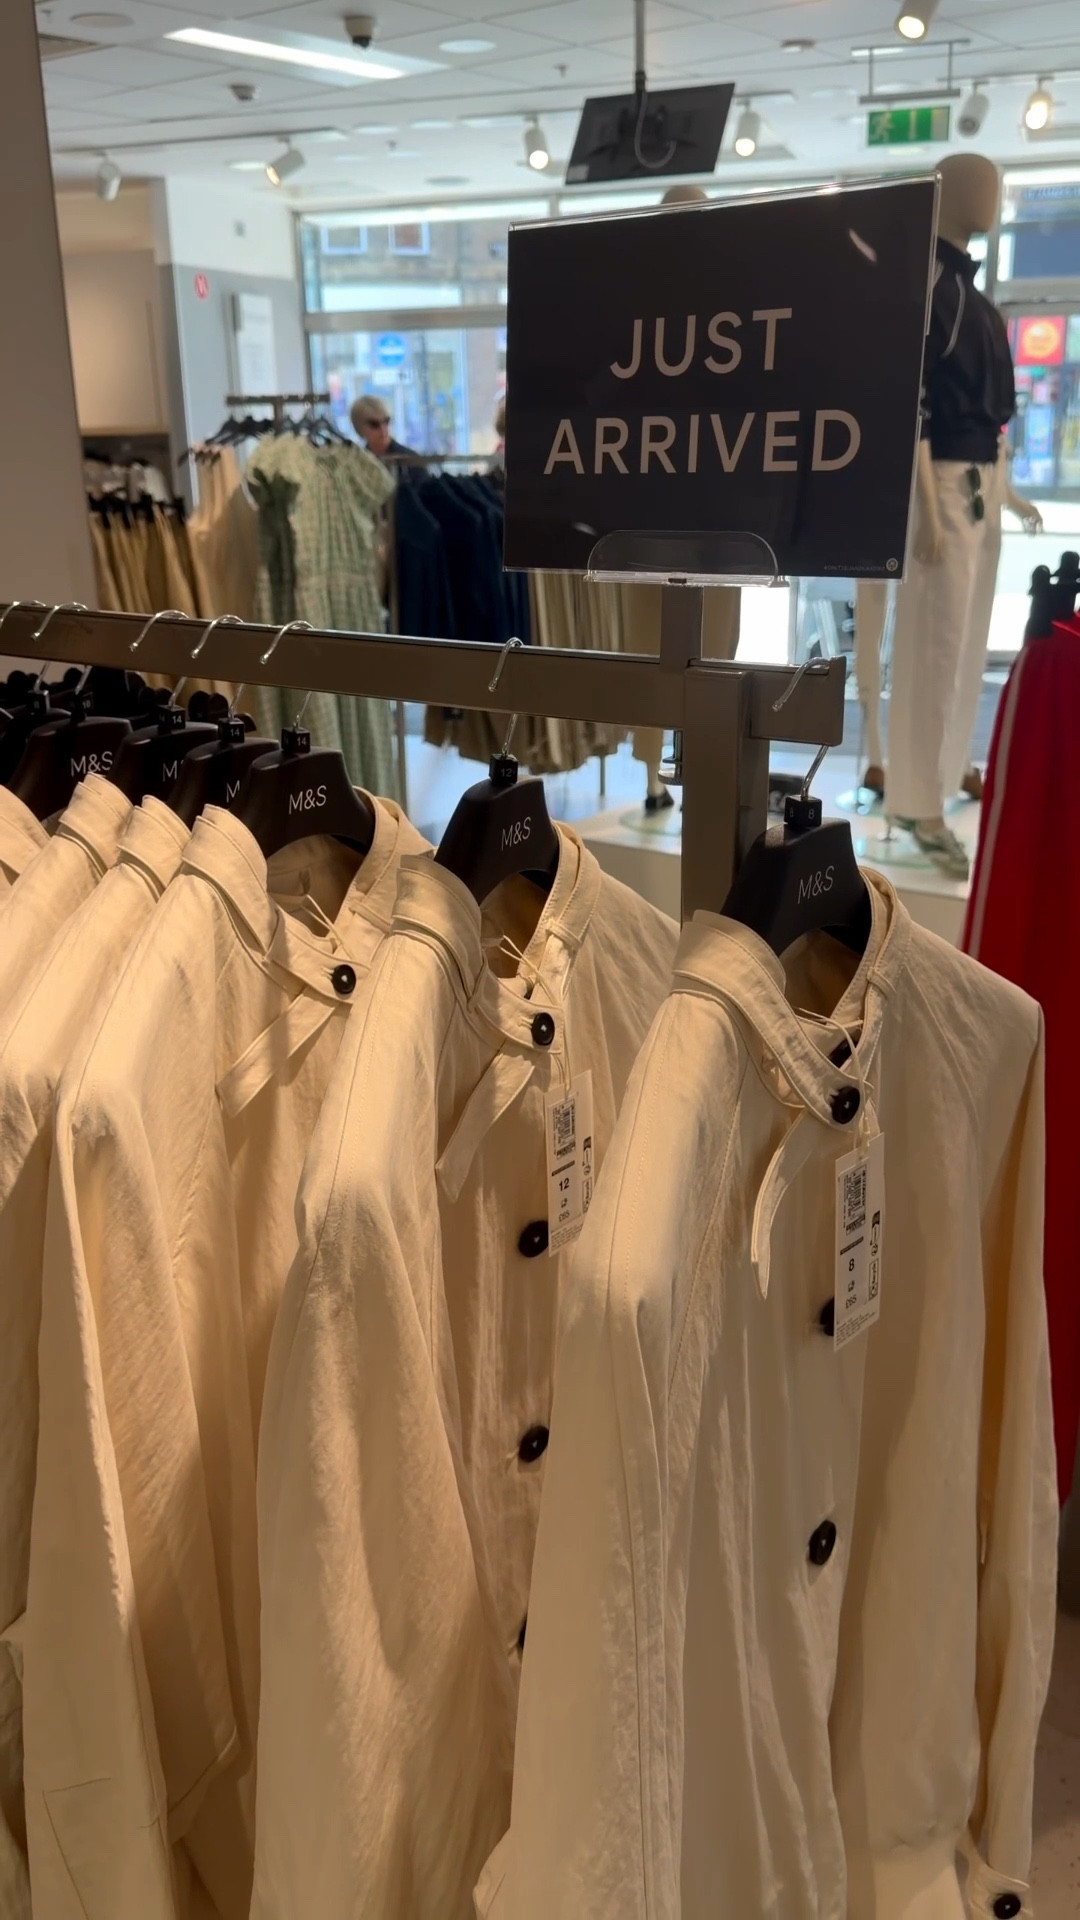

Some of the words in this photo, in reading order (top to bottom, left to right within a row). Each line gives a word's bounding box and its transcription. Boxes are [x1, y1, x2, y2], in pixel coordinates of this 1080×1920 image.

[610, 307, 793, 379] JUST
[543, 409, 862, 475] ARRIVED
[172, 714, 183, 725] 14
[229, 727, 241, 737] 14
[296, 736, 308, 747] 14
[70, 751, 113, 778] M&S
[500, 768, 513, 777] 12
[288, 785, 328, 815] M&S
[807, 808, 816, 820] 8
[501, 816, 532, 852] M&S
[797, 865, 835, 904] M&S
[558, 1177, 570, 1192] 12
[848, 1257, 855, 1271] 8
